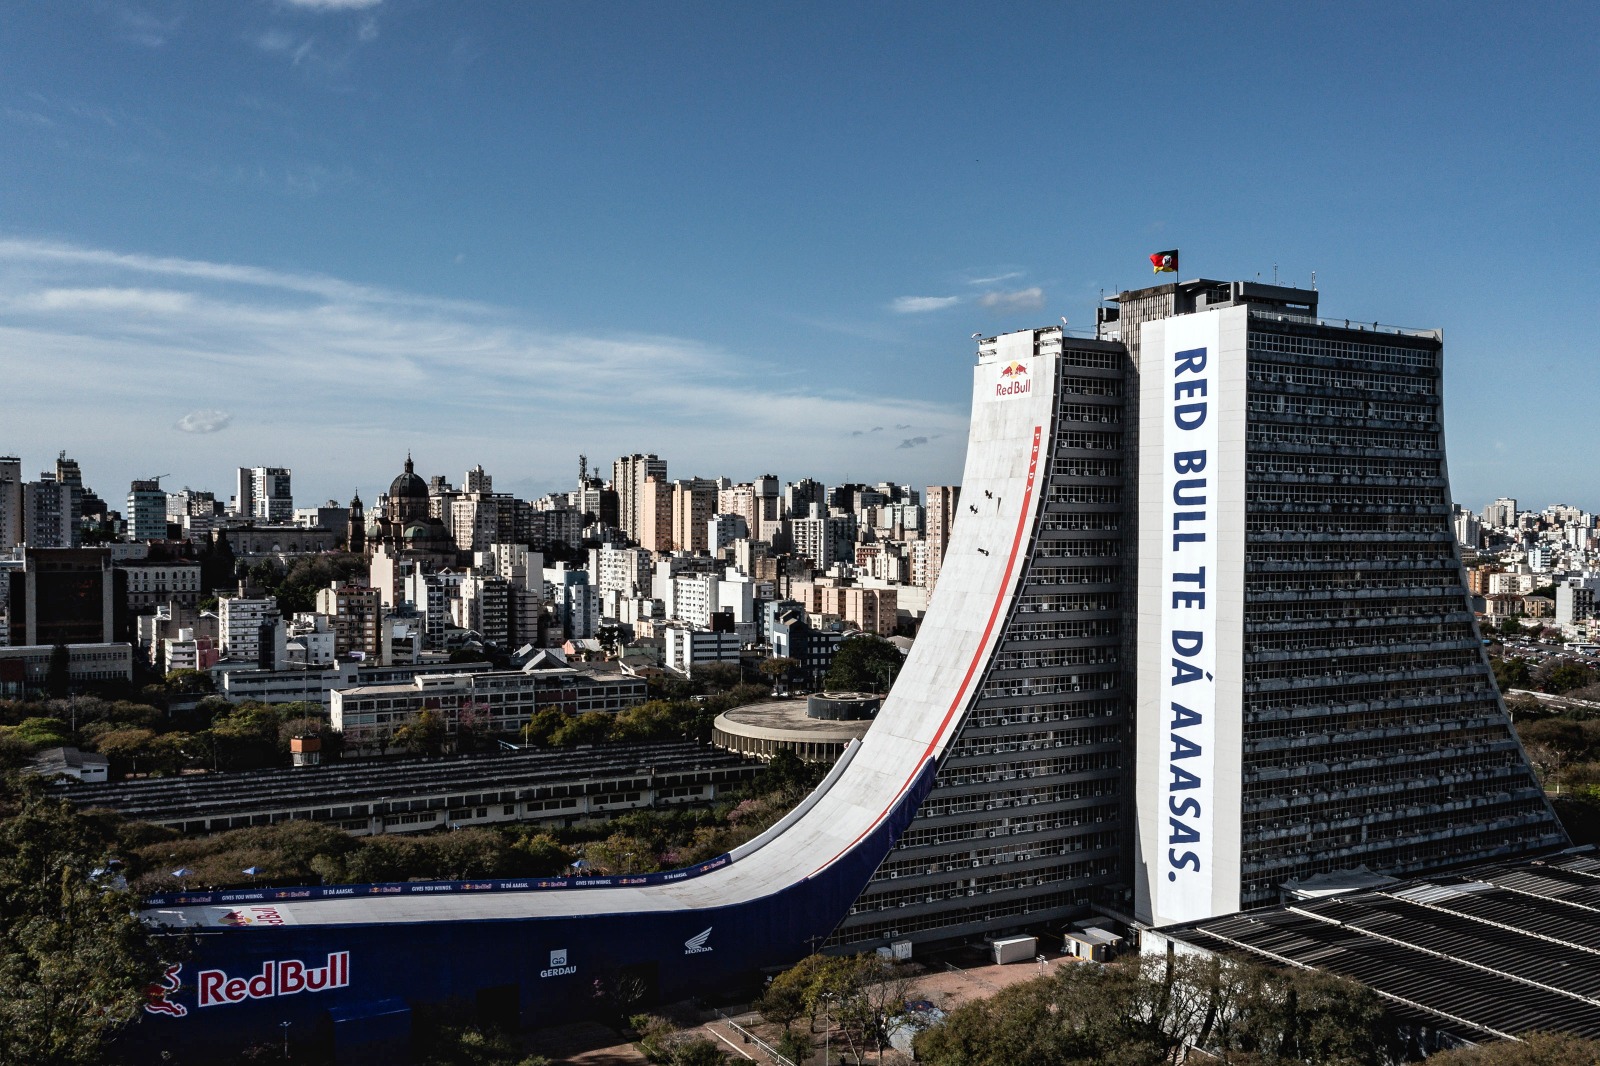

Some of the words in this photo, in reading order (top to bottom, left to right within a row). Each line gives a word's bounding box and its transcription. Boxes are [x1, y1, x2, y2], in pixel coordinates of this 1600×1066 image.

[996, 381, 1013, 396] Red
[1014, 379, 1031, 394] Bull
[1174, 347, 1208, 430] RED
[1026, 433, 1040, 492] PRADA
[1173, 450, 1207, 551] BULL
[1172, 566, 1206, 609] TE
[1171, 631, 1214, 686] DÁ
[1168, 702, 1203, 882] AAASAS.
[540, 965, 577, 978] GERDAU
[684, 946, 714, 955] HONDA
[198, 960, 276, 1008] Red
[277, 950, 350, 996] Bull
